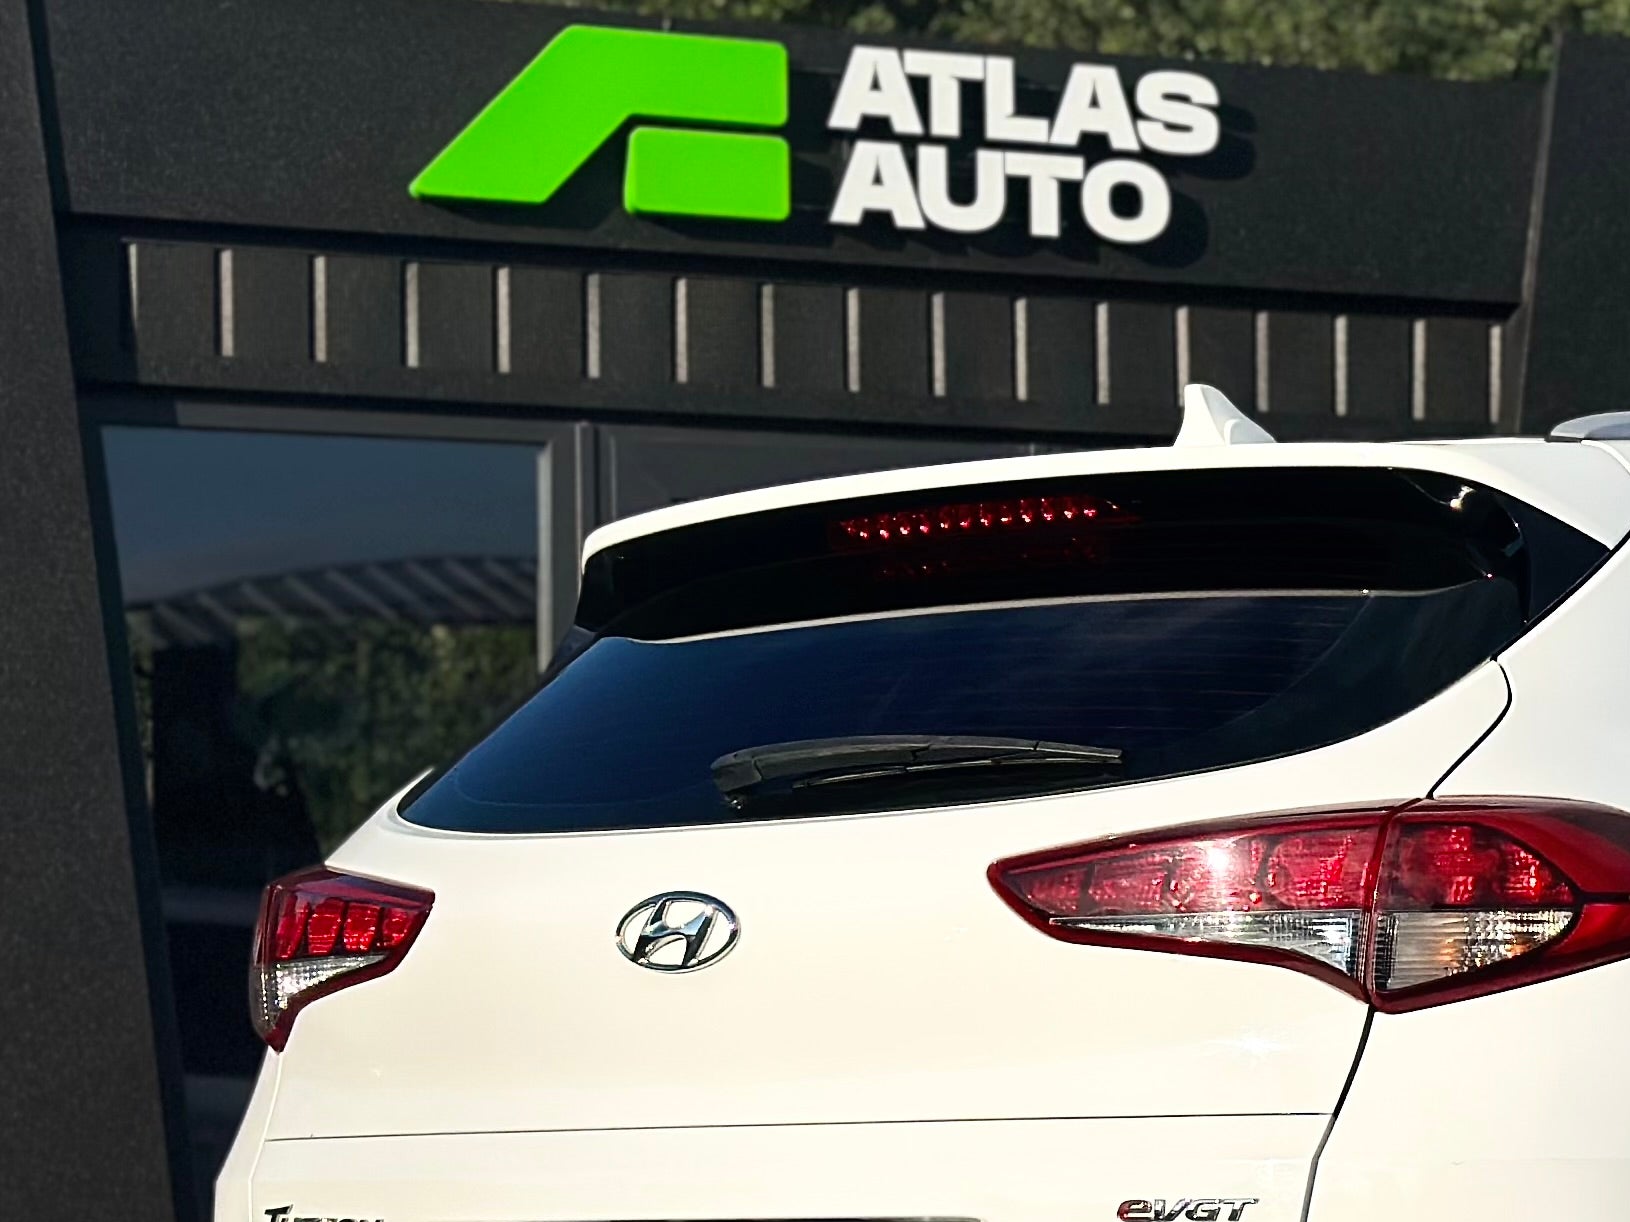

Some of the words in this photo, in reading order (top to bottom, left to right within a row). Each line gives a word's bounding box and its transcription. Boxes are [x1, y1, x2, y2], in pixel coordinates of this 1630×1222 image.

[826, 45, 1220, 156] ATLAS
[828, 139, 1172, 243] AUTO
[1116, 1198, 1260, 1222] eVGT
